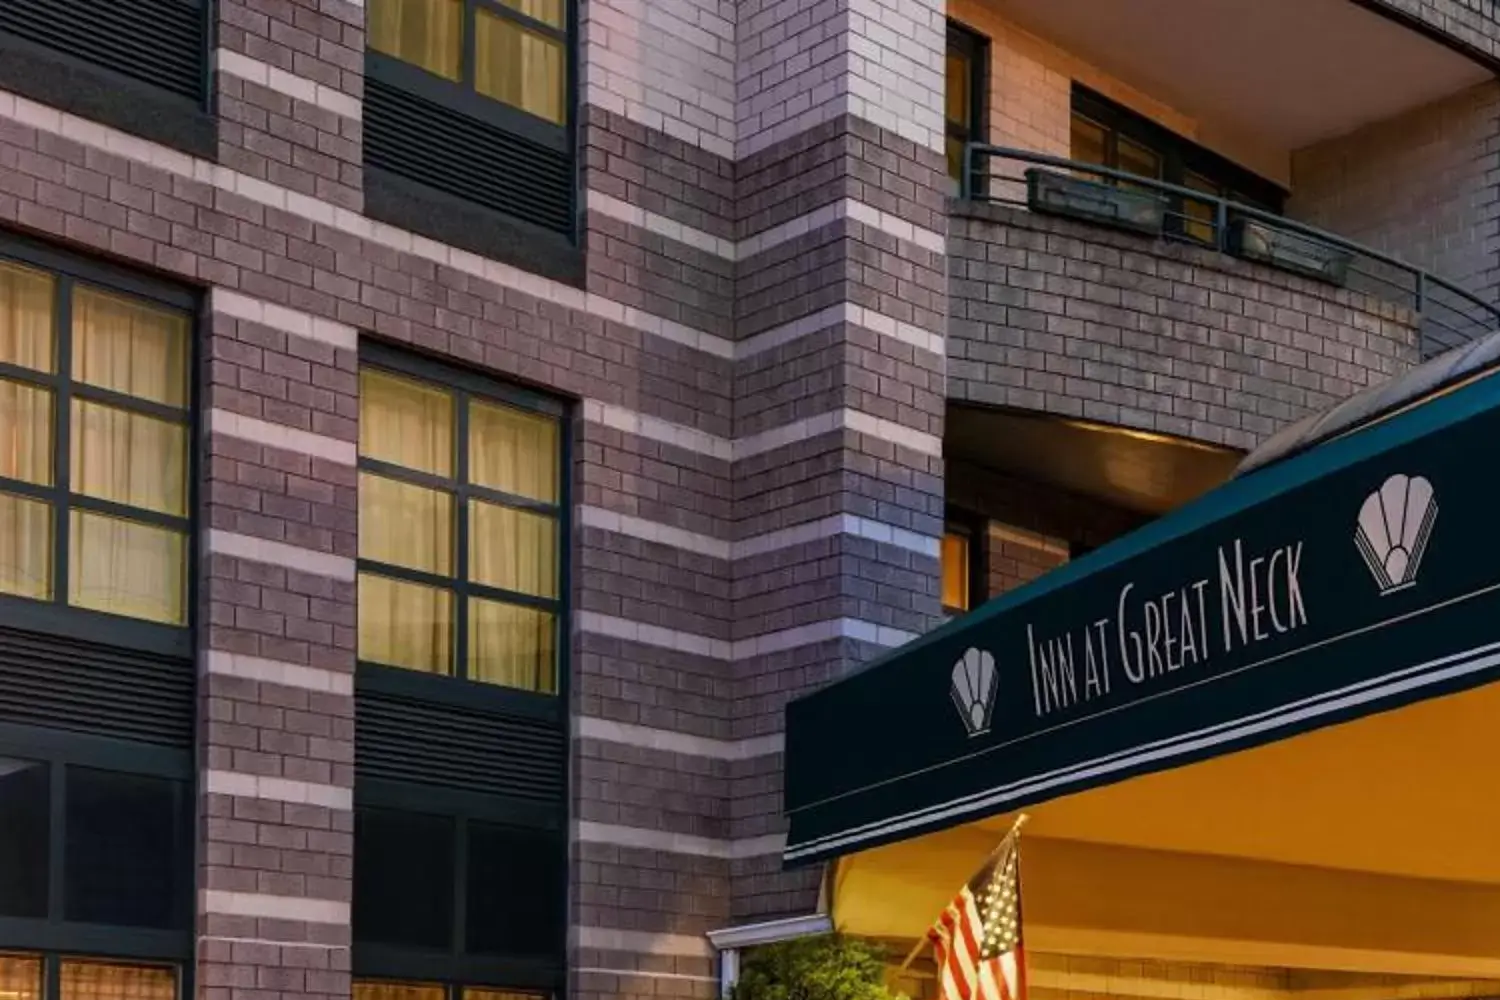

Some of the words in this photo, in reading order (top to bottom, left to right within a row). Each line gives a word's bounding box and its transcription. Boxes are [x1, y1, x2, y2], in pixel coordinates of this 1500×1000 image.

[1027, 623, 1080, 716] INN
[1084, 618, 1111, 701] AT
[1118, 582, 1210, 684] GREAT
[1217, 538, 1308, 651] NECK
